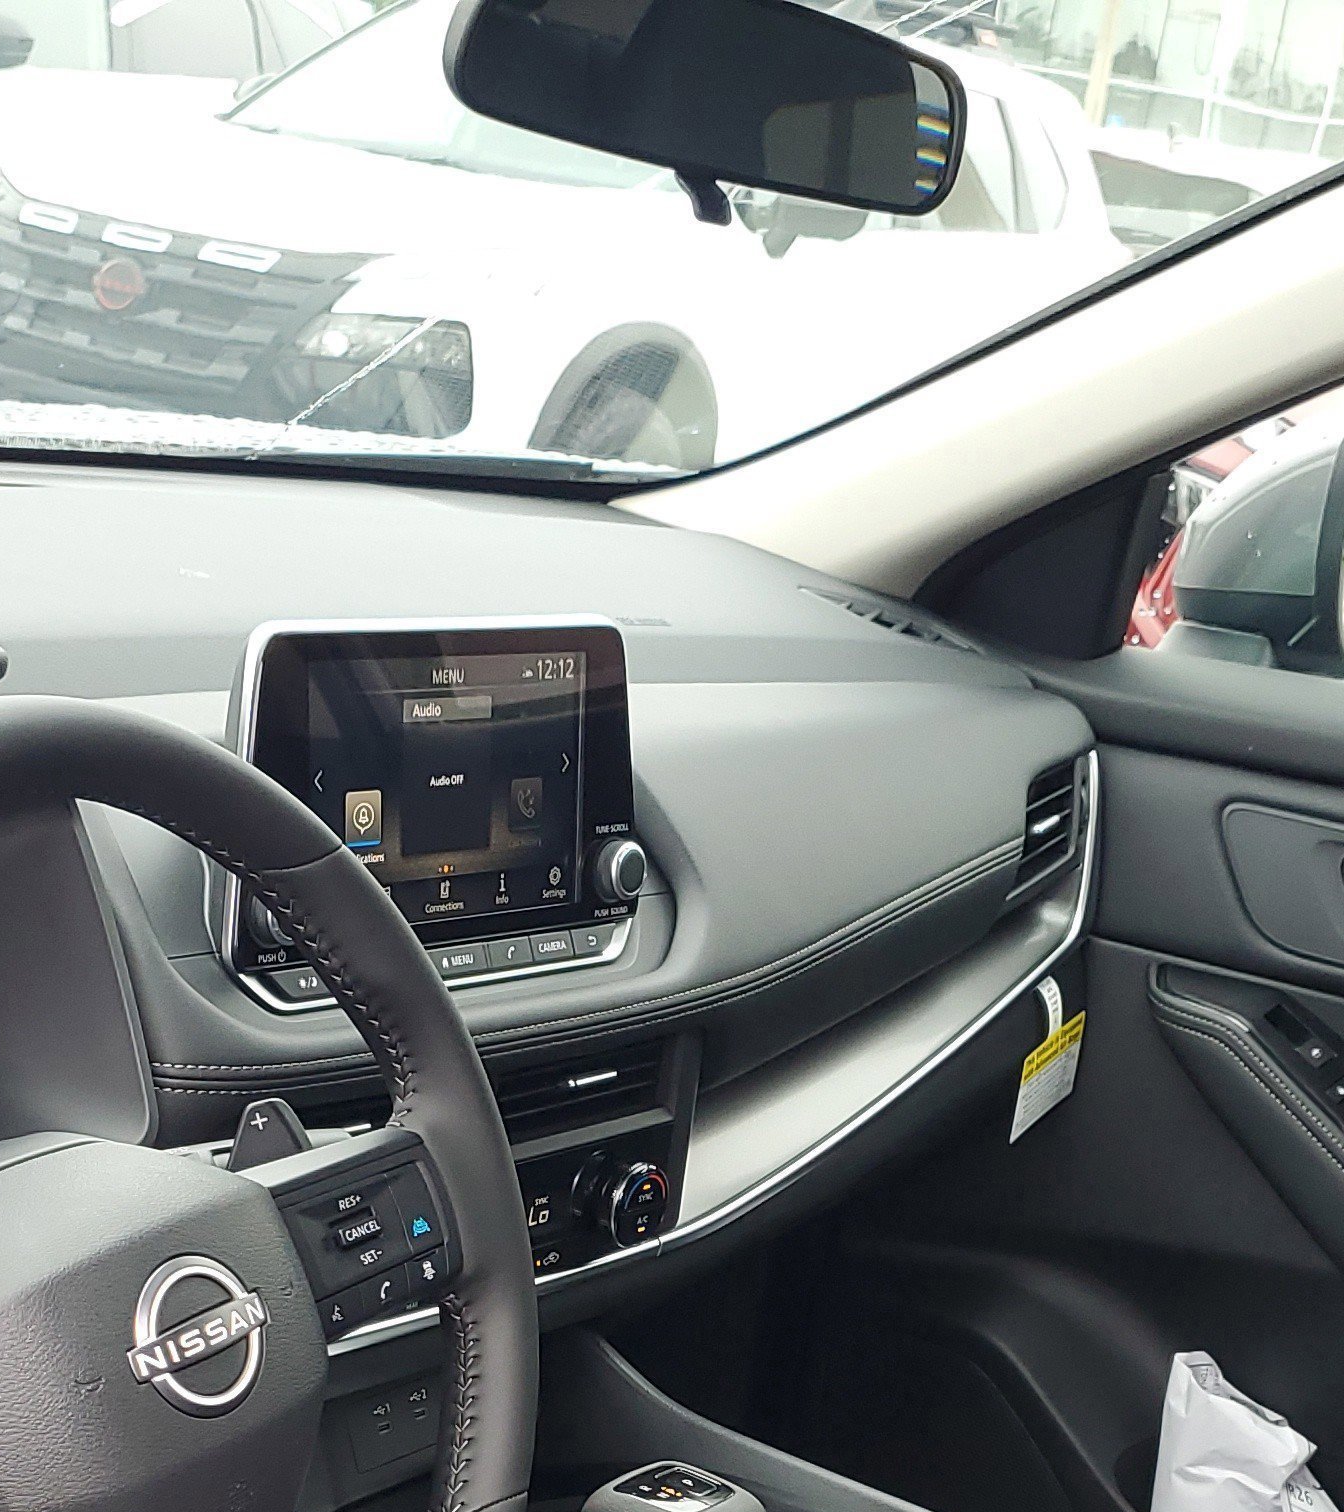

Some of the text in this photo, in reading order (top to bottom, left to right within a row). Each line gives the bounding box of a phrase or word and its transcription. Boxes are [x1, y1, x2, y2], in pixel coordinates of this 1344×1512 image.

[432, 658, 575, 684] MENU 12:12
[412, 702, 442, 718] Audio
[429, 776, 450, 787] Audio
[495, 895, 509, 905] Info
[542, 889, 566, 900] Settings
[425, 901, 464, 914] Connections
[594, 909, 609, 918] PUSH
[537, 941, 567, 953] CAMERA
[257, 952, 277, 963] PUSH
[451, 953, 474, 967] MENU
[338, 1195, 362, 1211] RES+
[345, 1219, 381, 1241] CANCEL
[134, 1298, 265, 1377] NISSAN
